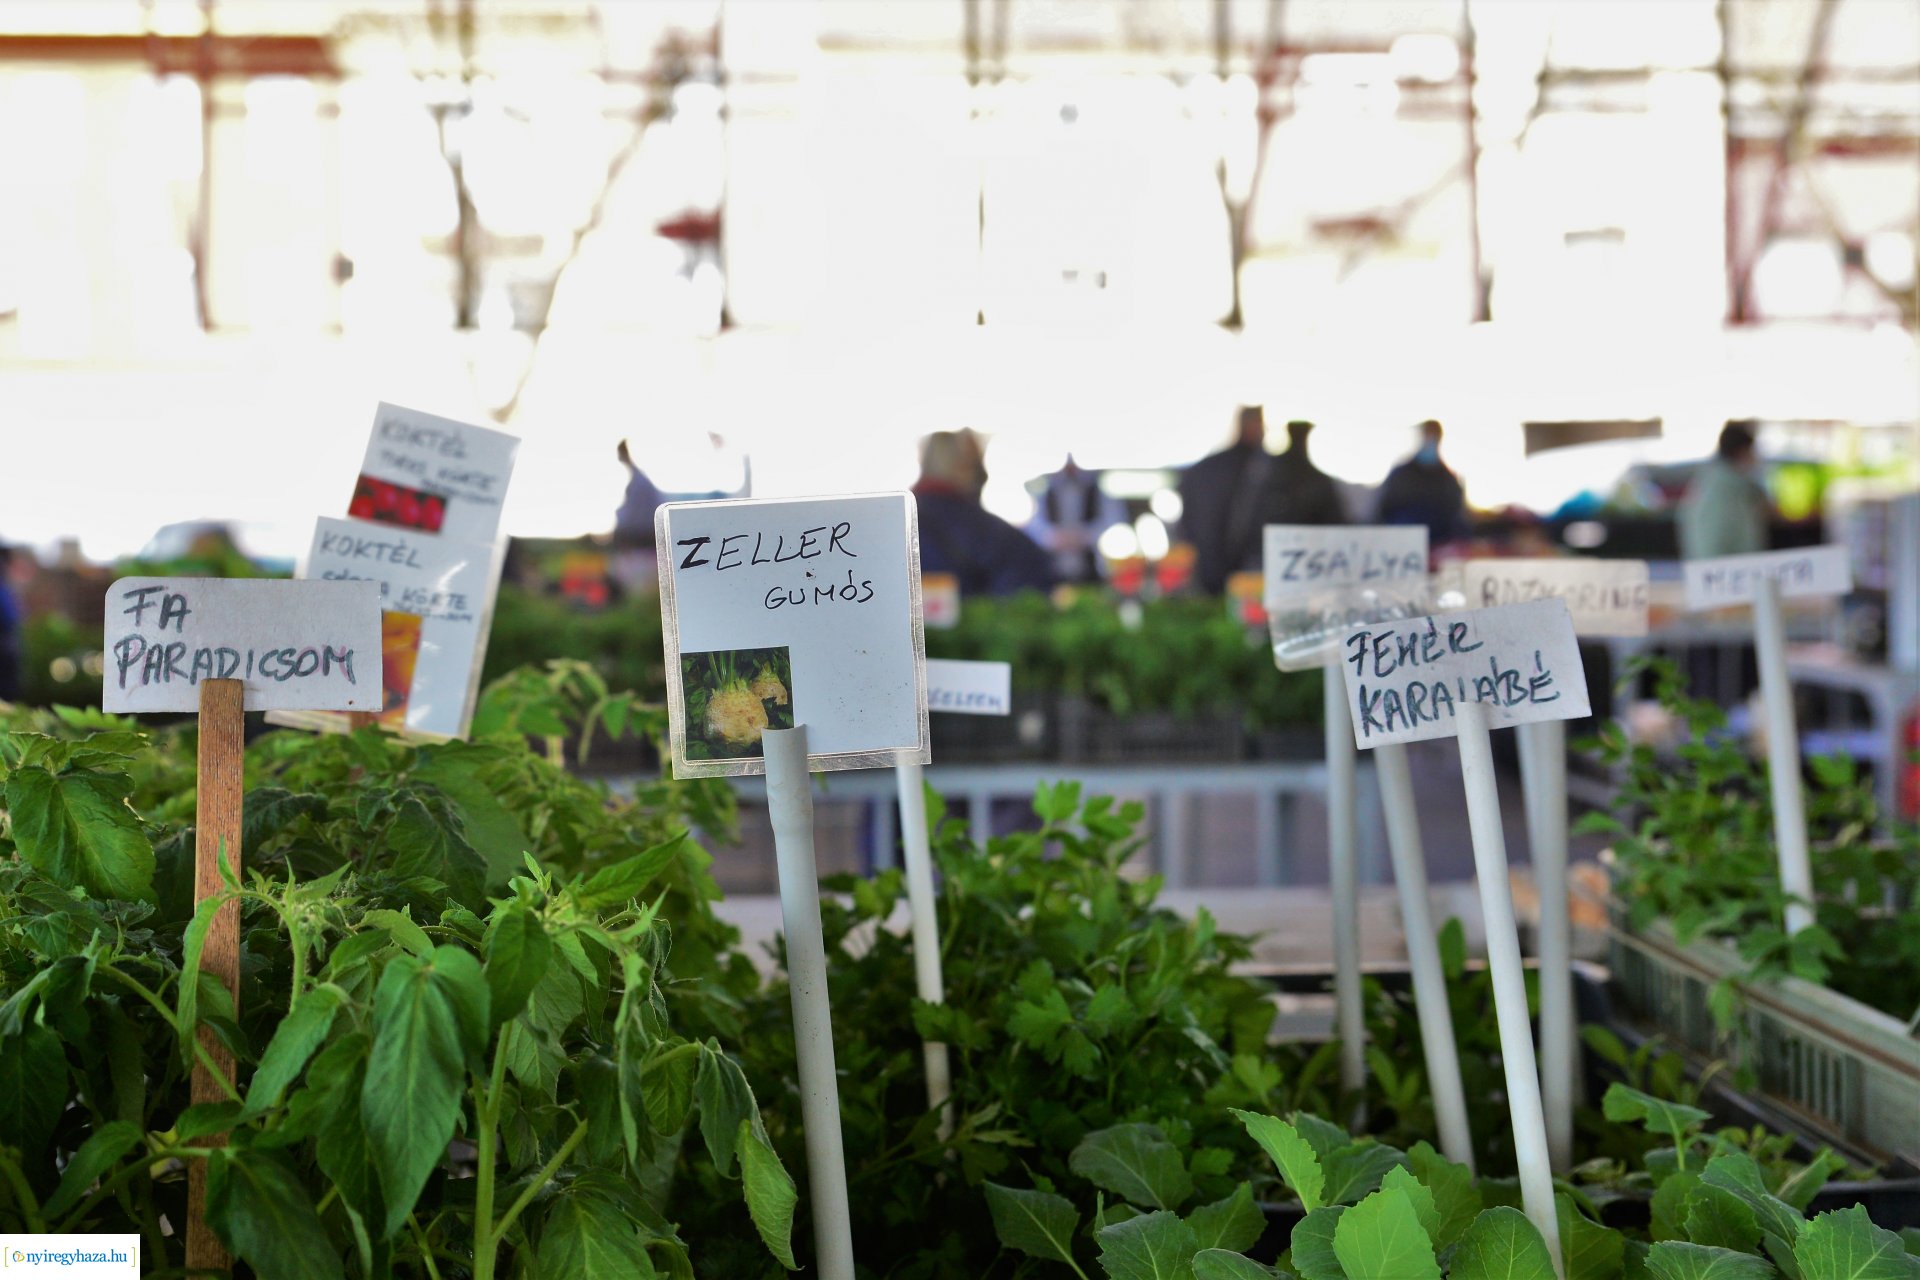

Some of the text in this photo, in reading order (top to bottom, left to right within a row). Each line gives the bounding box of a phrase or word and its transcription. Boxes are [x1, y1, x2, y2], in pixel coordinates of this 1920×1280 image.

[677, 521, 857, 571] ZELLER
[123, 585, 192, 633] FA
[113, 633, 356, 690] PARADICSOM
[1346, 616, 1484, 678] FEHÉR
